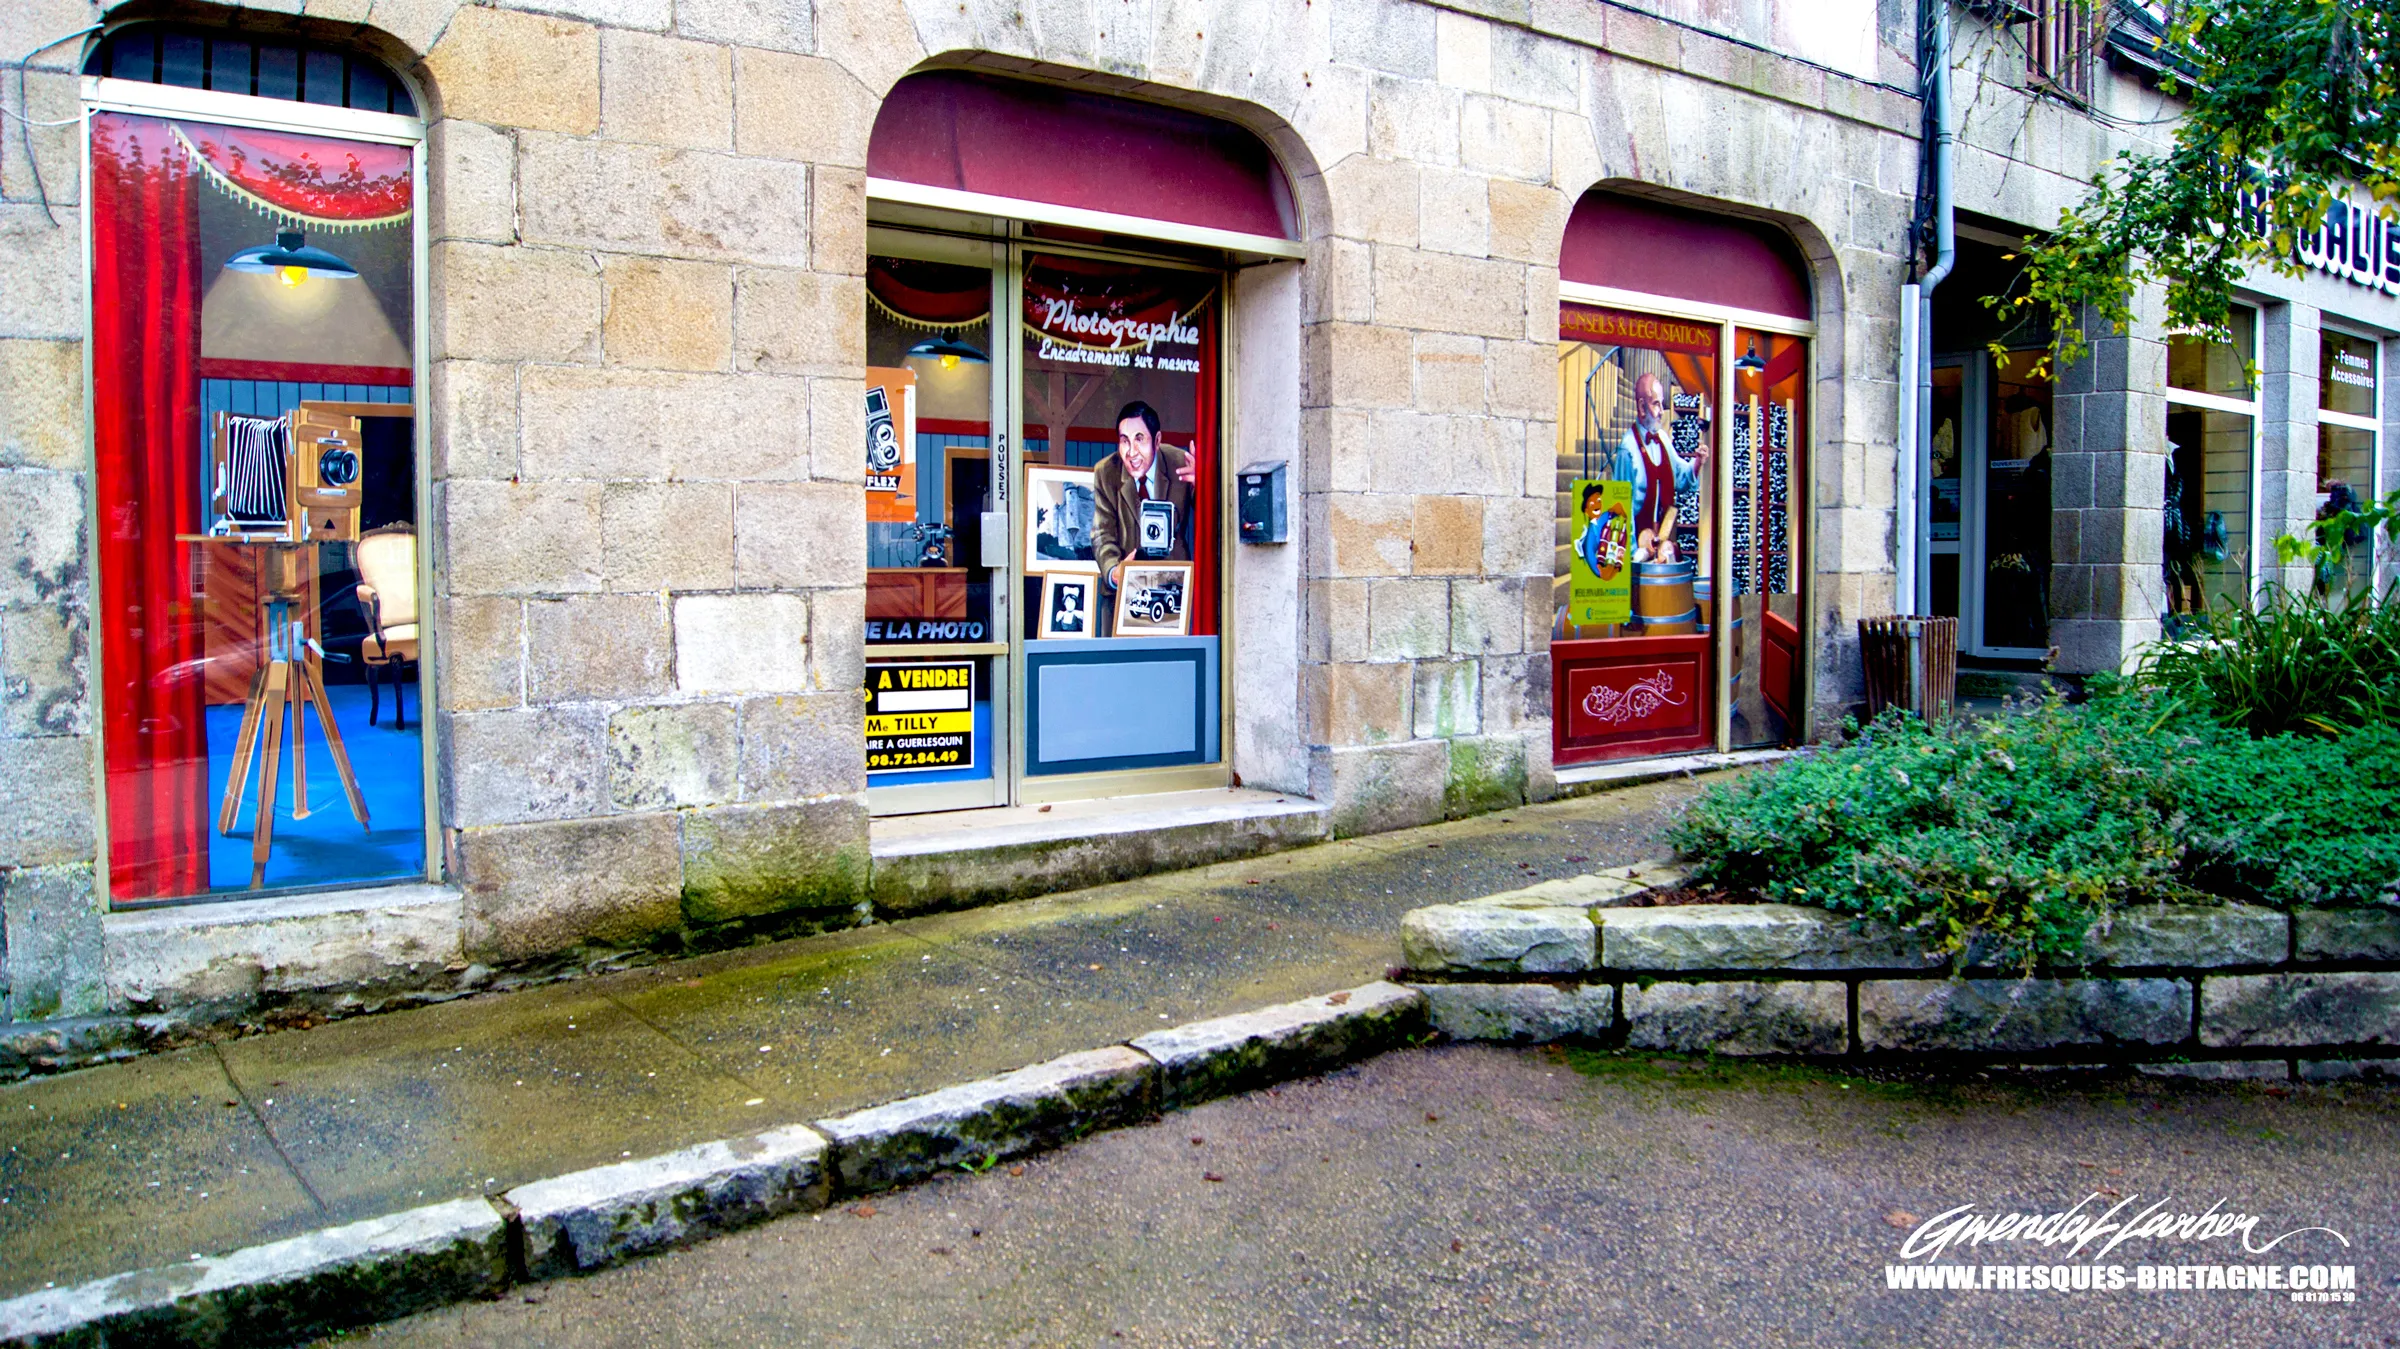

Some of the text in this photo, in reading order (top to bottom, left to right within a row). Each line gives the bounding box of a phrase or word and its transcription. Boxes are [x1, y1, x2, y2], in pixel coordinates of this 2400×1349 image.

[1042, 297, 1199, 353] Photographie
[1617, 317, 1627, 335] &
[1629, 318, 1713, 347] DEGUSTATIONS
[1038, 337, 1200, 373] Encadrements sur mesure
[2339, 349, 2370, 370] Femmes
[2330, 365, 2375, 389] Accessoires
[997, 434, 1005, 500] POUSSEZ
[885, 622, 912, 639] LA
[917, 621, 983, 639] PHOTO
[878, 668, 969, 689] A VENDRE
[894, 716, 938, 731] TILLY
[886, 739, 894, 749] A
[897, 736, 963, 749] GUERLESQUIN
